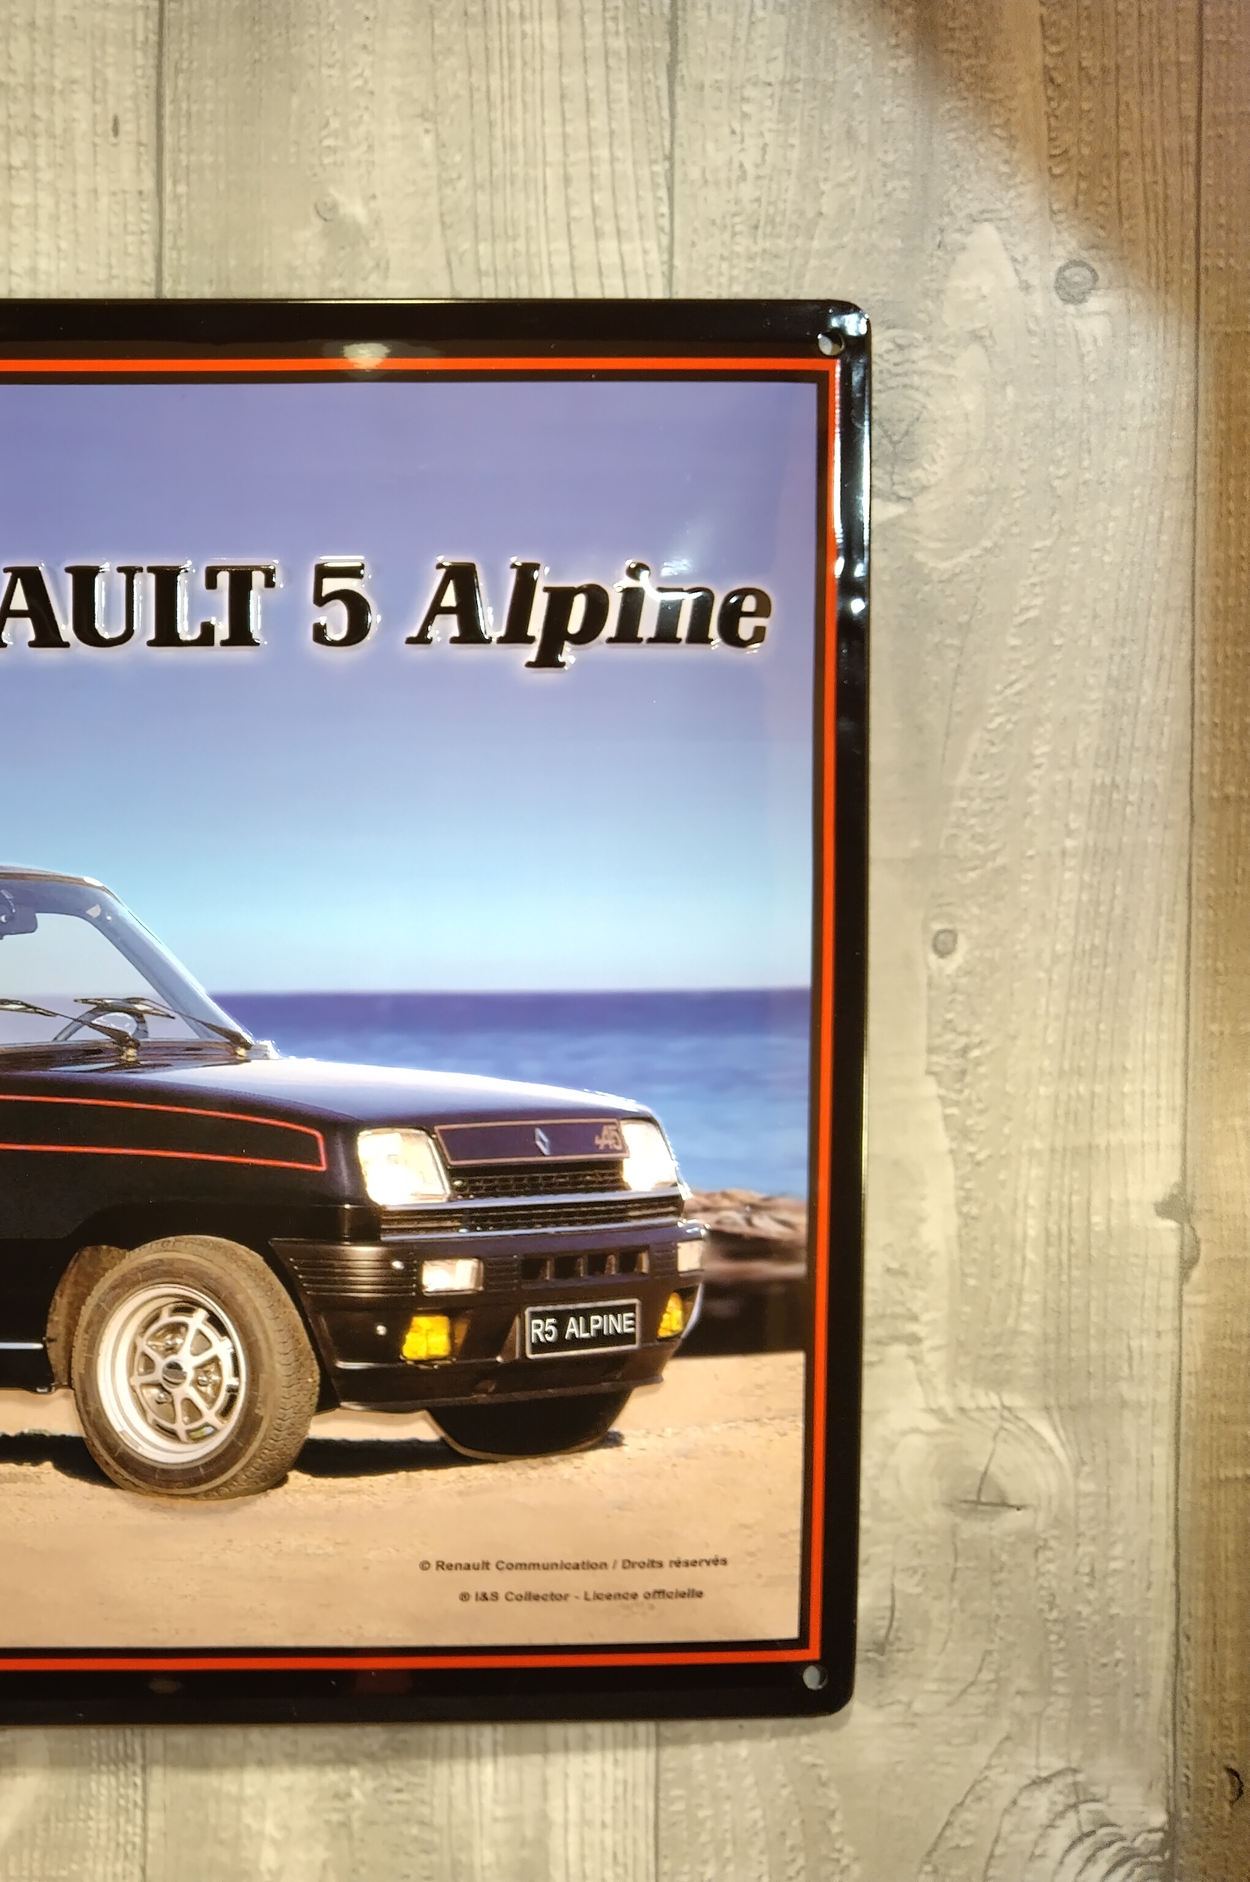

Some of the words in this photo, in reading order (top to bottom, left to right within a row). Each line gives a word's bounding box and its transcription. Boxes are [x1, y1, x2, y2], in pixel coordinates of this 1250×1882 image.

[312, 561, 373, 648] 5
[404, 561, 772, 669] Alpine
[531, 1318, 558, 1343] R5
[565, 1312, 635, 1340] ALPINE
[435, 1560, 491, 1571] Renault
[495, 1559, 608, 1571] Communication
[621, 1558, 664, 1570] Droits
[669, 1555, 728, 1568] réservés
[504, 1591, 570, 1602] Collector
[584, 1590, 639, 1601] Licence
[643, 1588, 704, 1600] officielle
